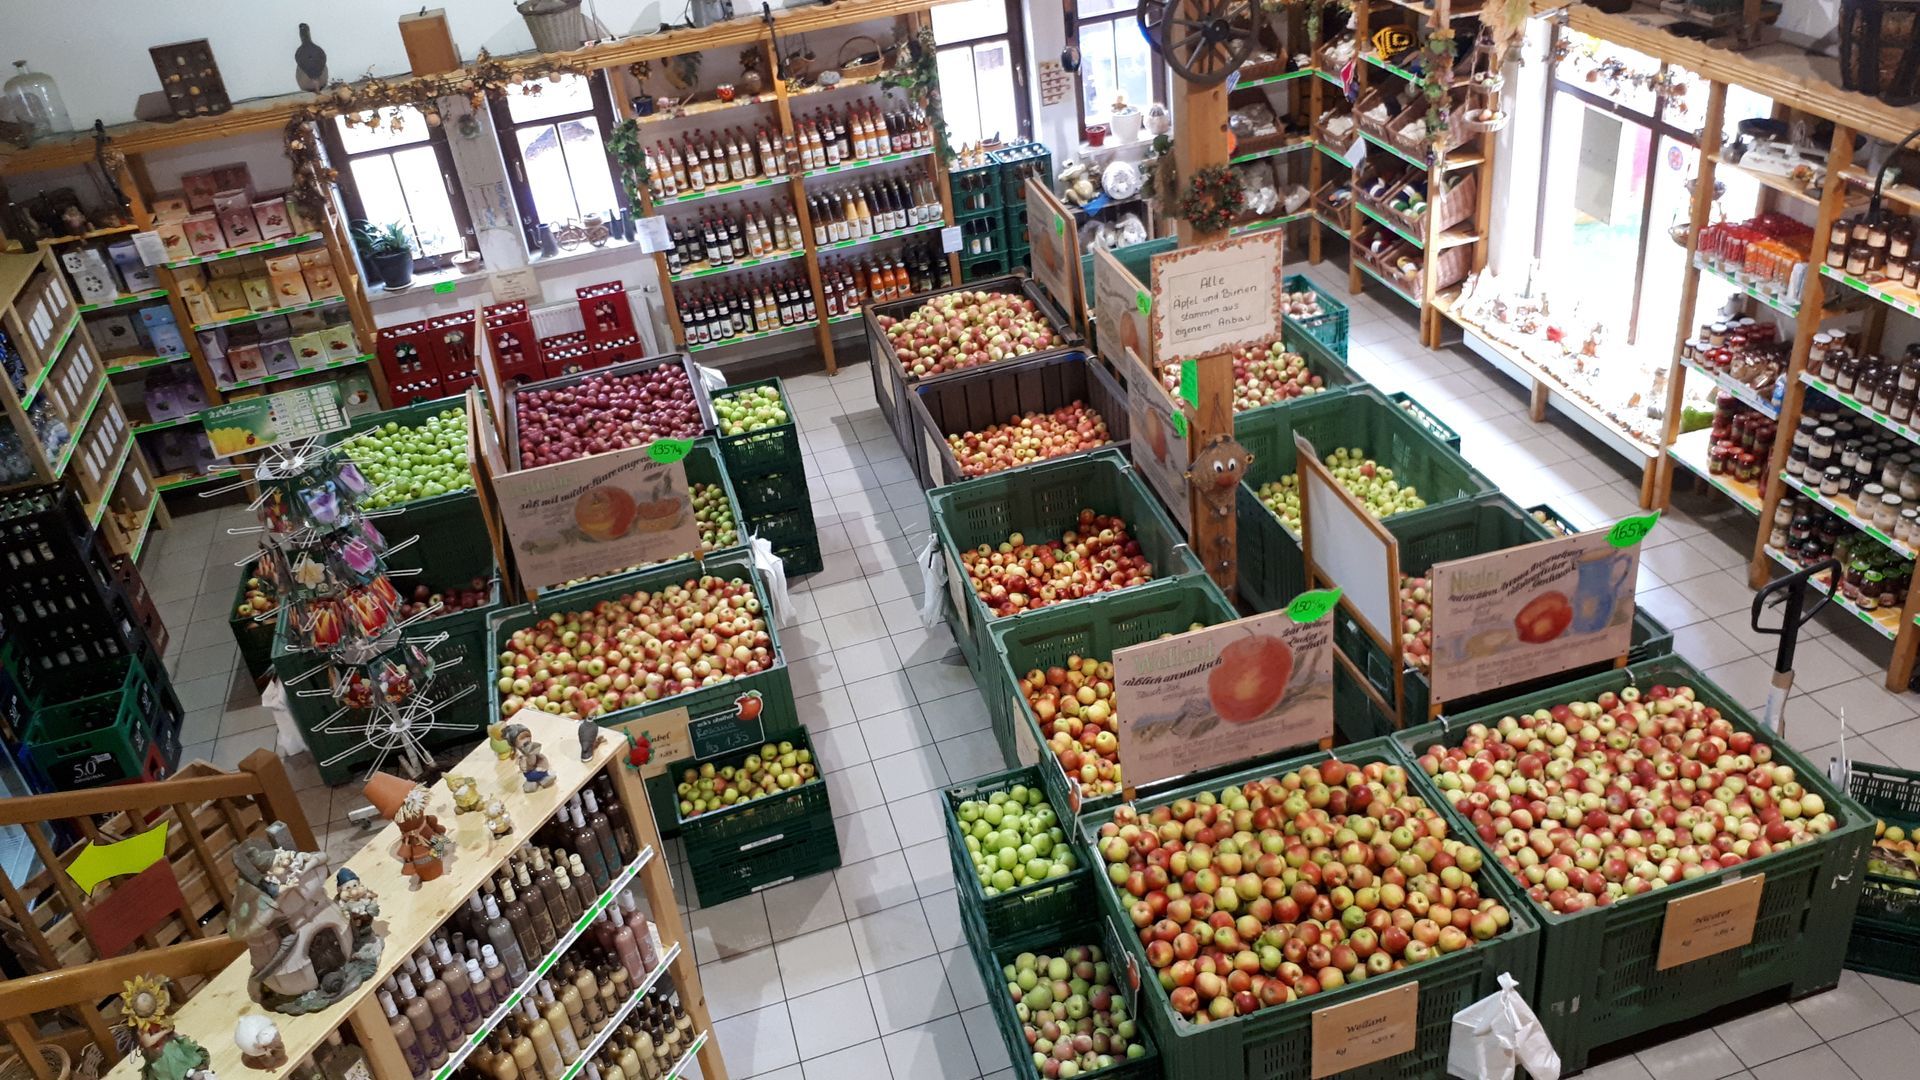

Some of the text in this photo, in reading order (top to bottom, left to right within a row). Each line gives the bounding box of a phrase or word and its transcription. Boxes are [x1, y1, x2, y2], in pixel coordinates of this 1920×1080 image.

[1200, 276, 1225, 289] Alle
[1173, 285, 1257, 310] Äpfel und Birnen
[1181, 303, 1239, 322] stammen aus
[1175, 315, 1252, 338] eigenem Anbau
[1133, 639, 1215, 674] Wellant
[1162, 655, 1223, 683] aromatisch
[74, 758, 97, 779] 5.0
